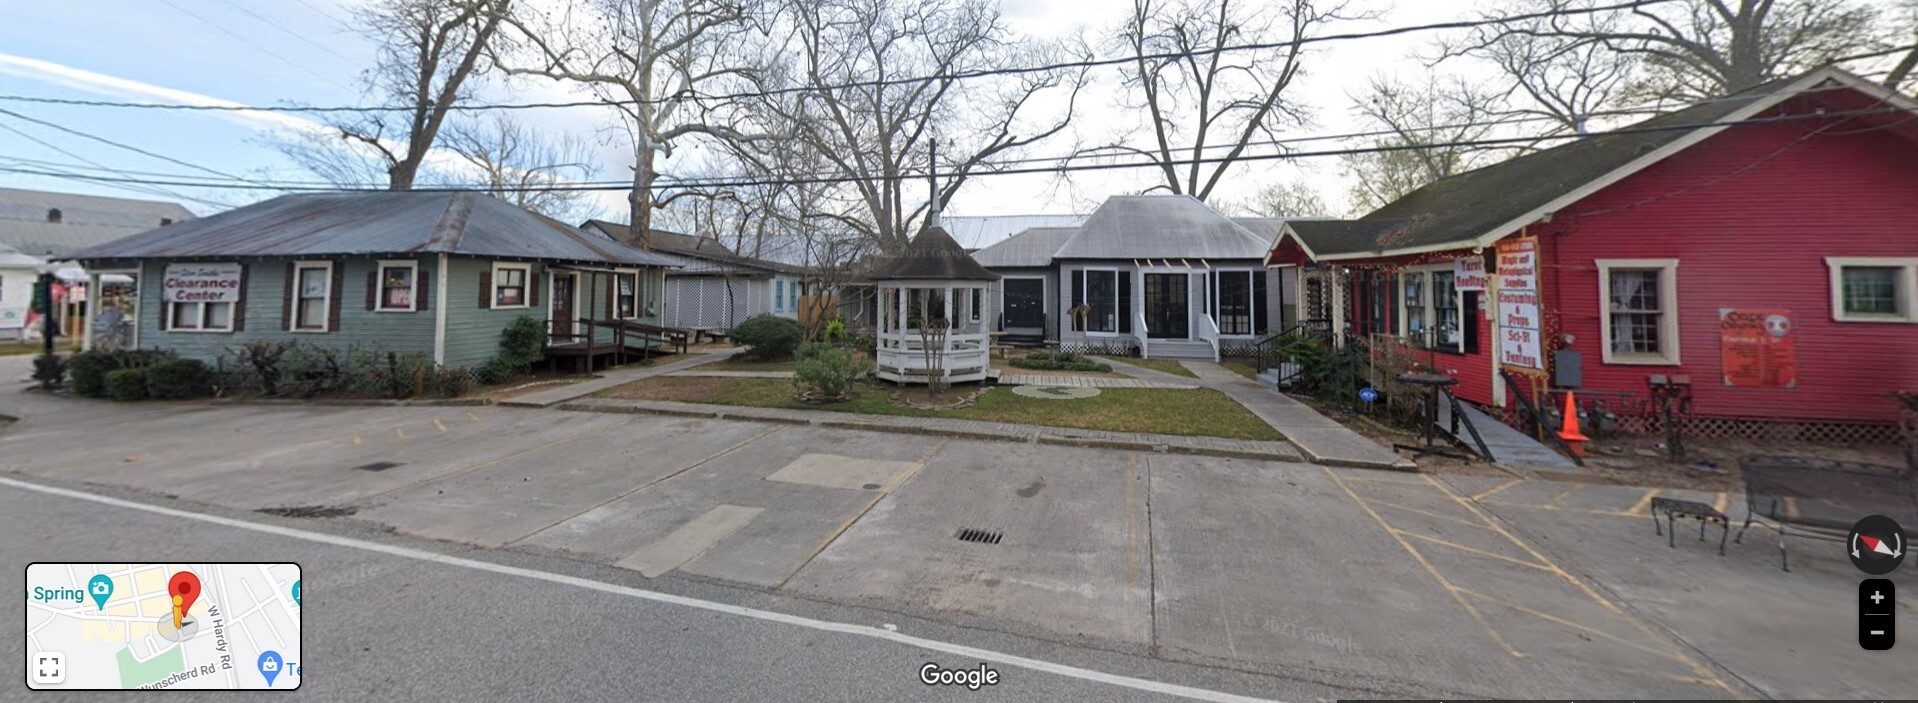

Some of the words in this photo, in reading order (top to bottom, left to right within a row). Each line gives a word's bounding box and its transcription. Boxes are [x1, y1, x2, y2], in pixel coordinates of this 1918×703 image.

[166, 278, 239, 289] Clearance
[176, 289, 225, 300] Center
[1500, 292, 1537, 306] Costuming
[1508, 313, 1530, 327] Props
[1505, 350, 1537, 368] Fantasy
